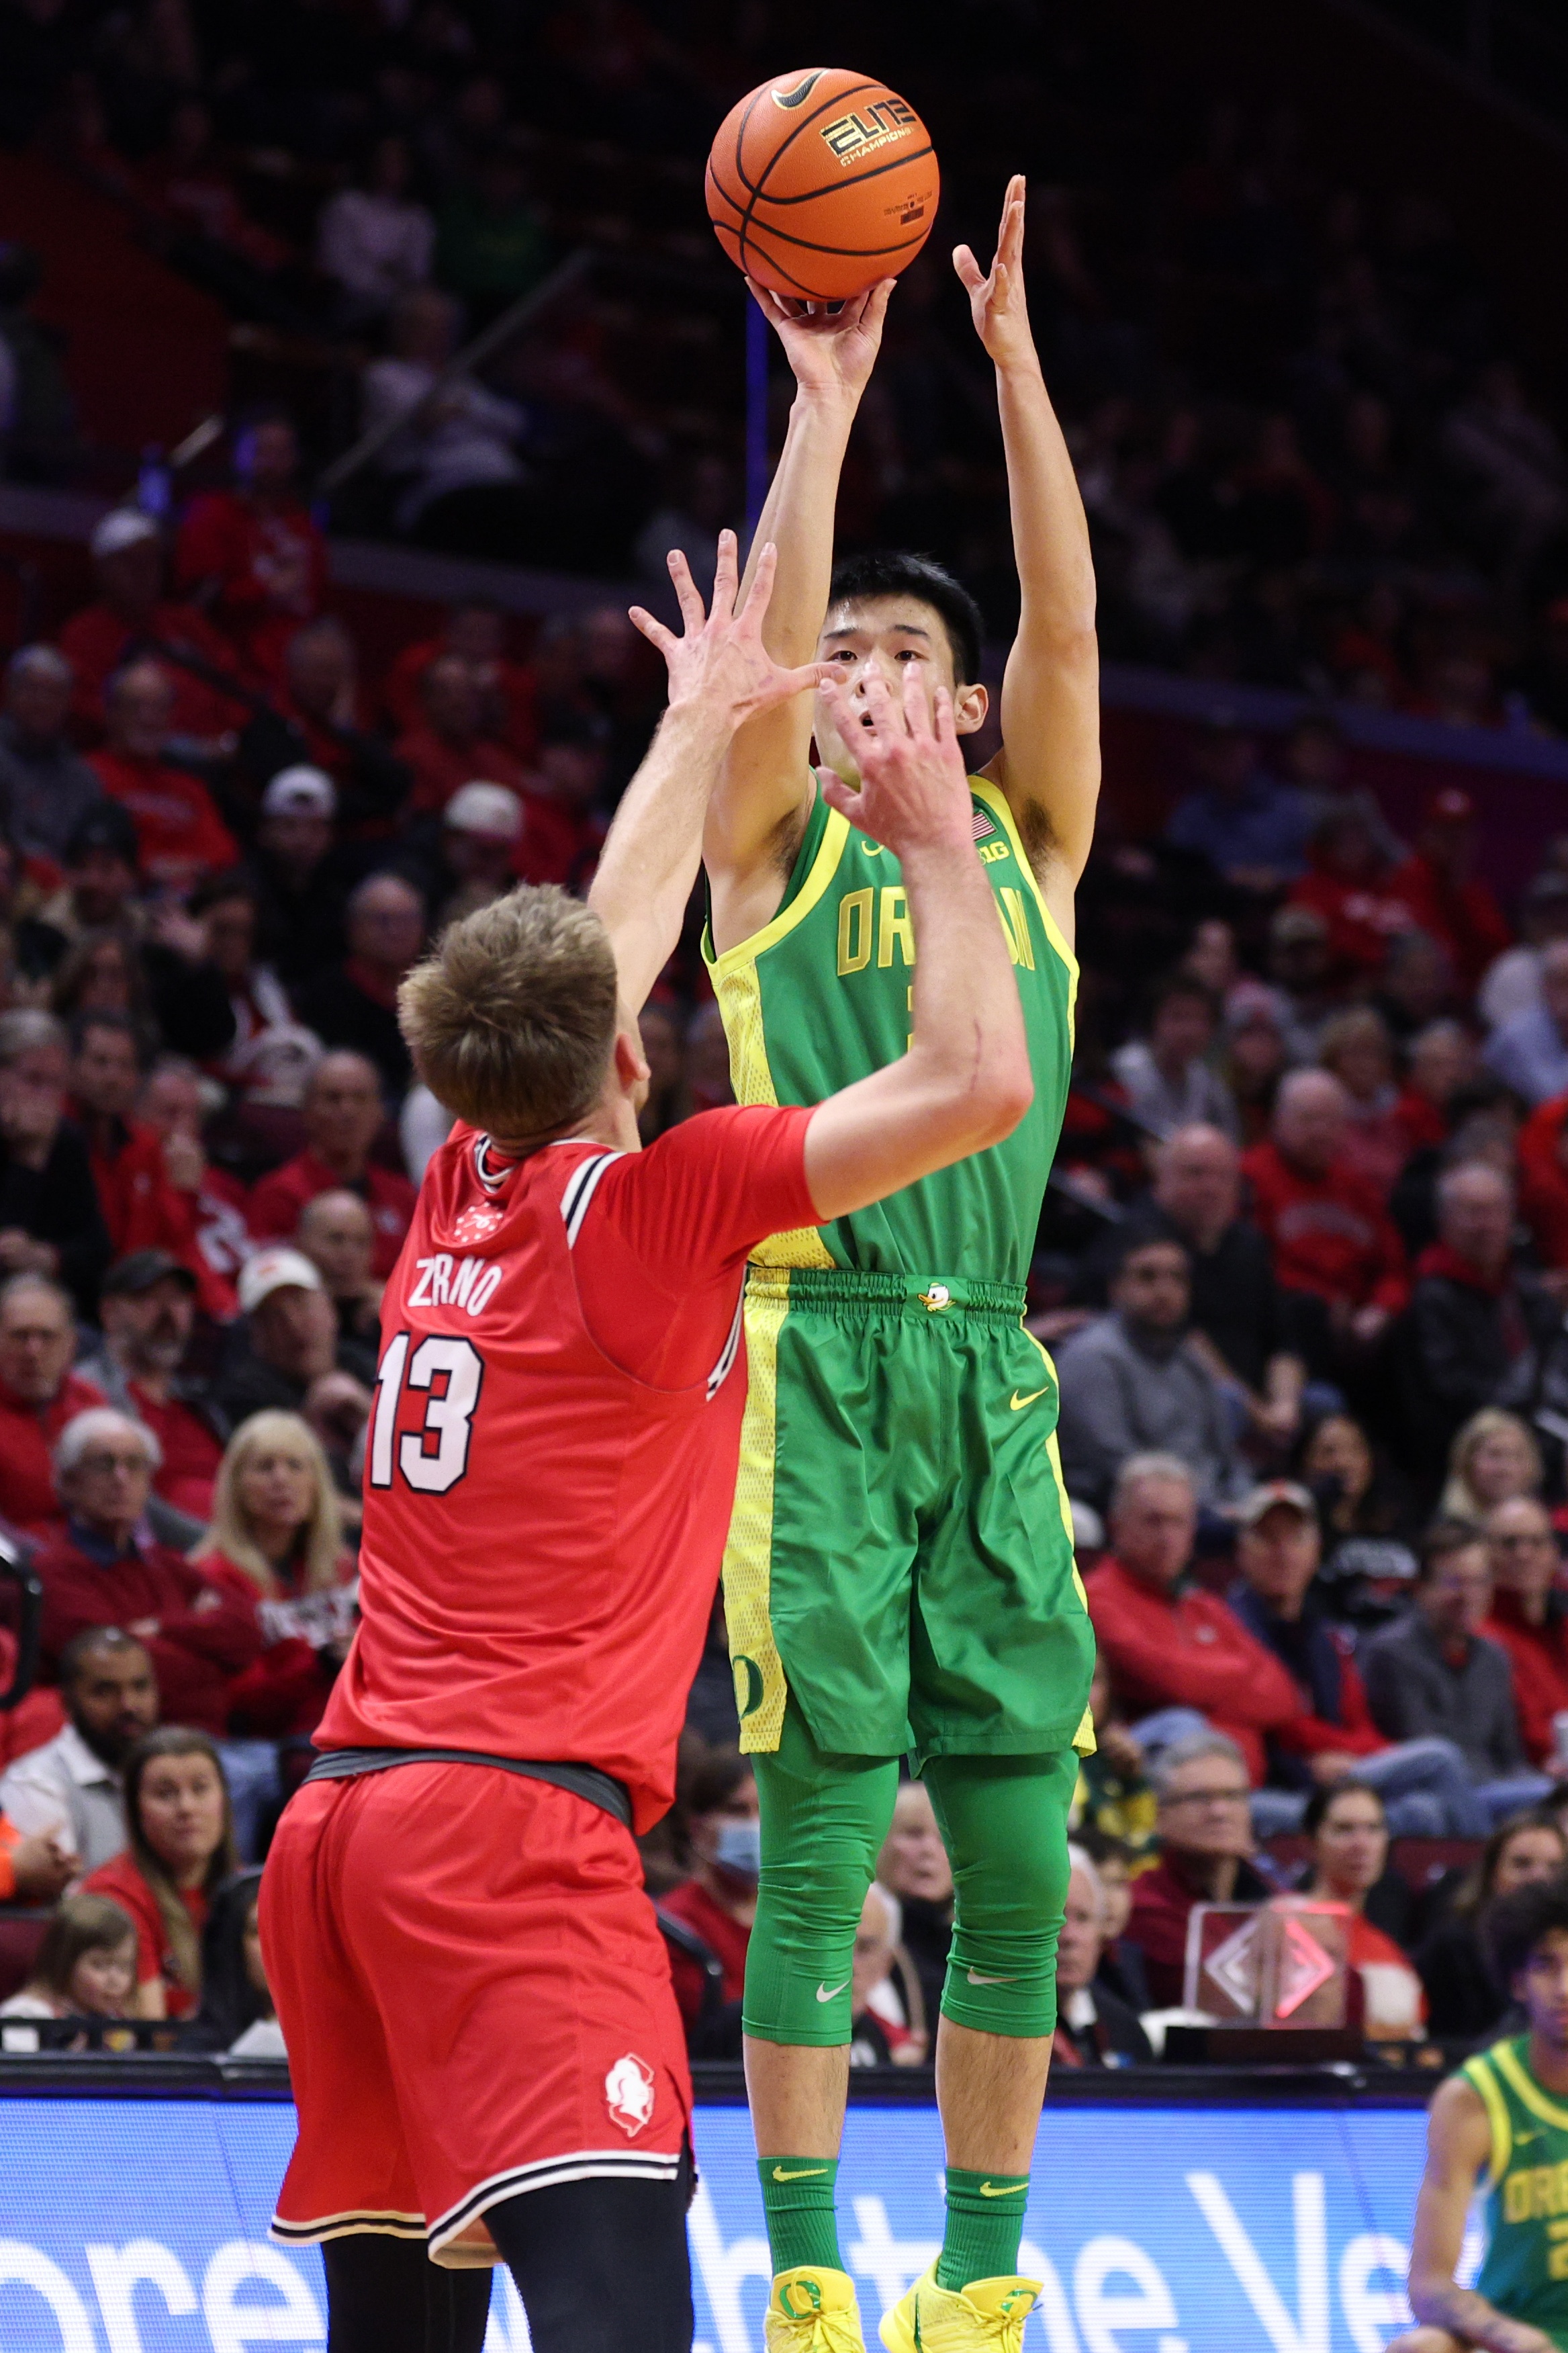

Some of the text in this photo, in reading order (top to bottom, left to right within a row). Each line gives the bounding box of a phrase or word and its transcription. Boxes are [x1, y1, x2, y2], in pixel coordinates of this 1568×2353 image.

[820, 99, 917, 157] ELITE
[977, 841, 1010, 866] 1G
[407, 1253, 502, 1317] ZRNO
[372, 1331, 484, 1495] 13
